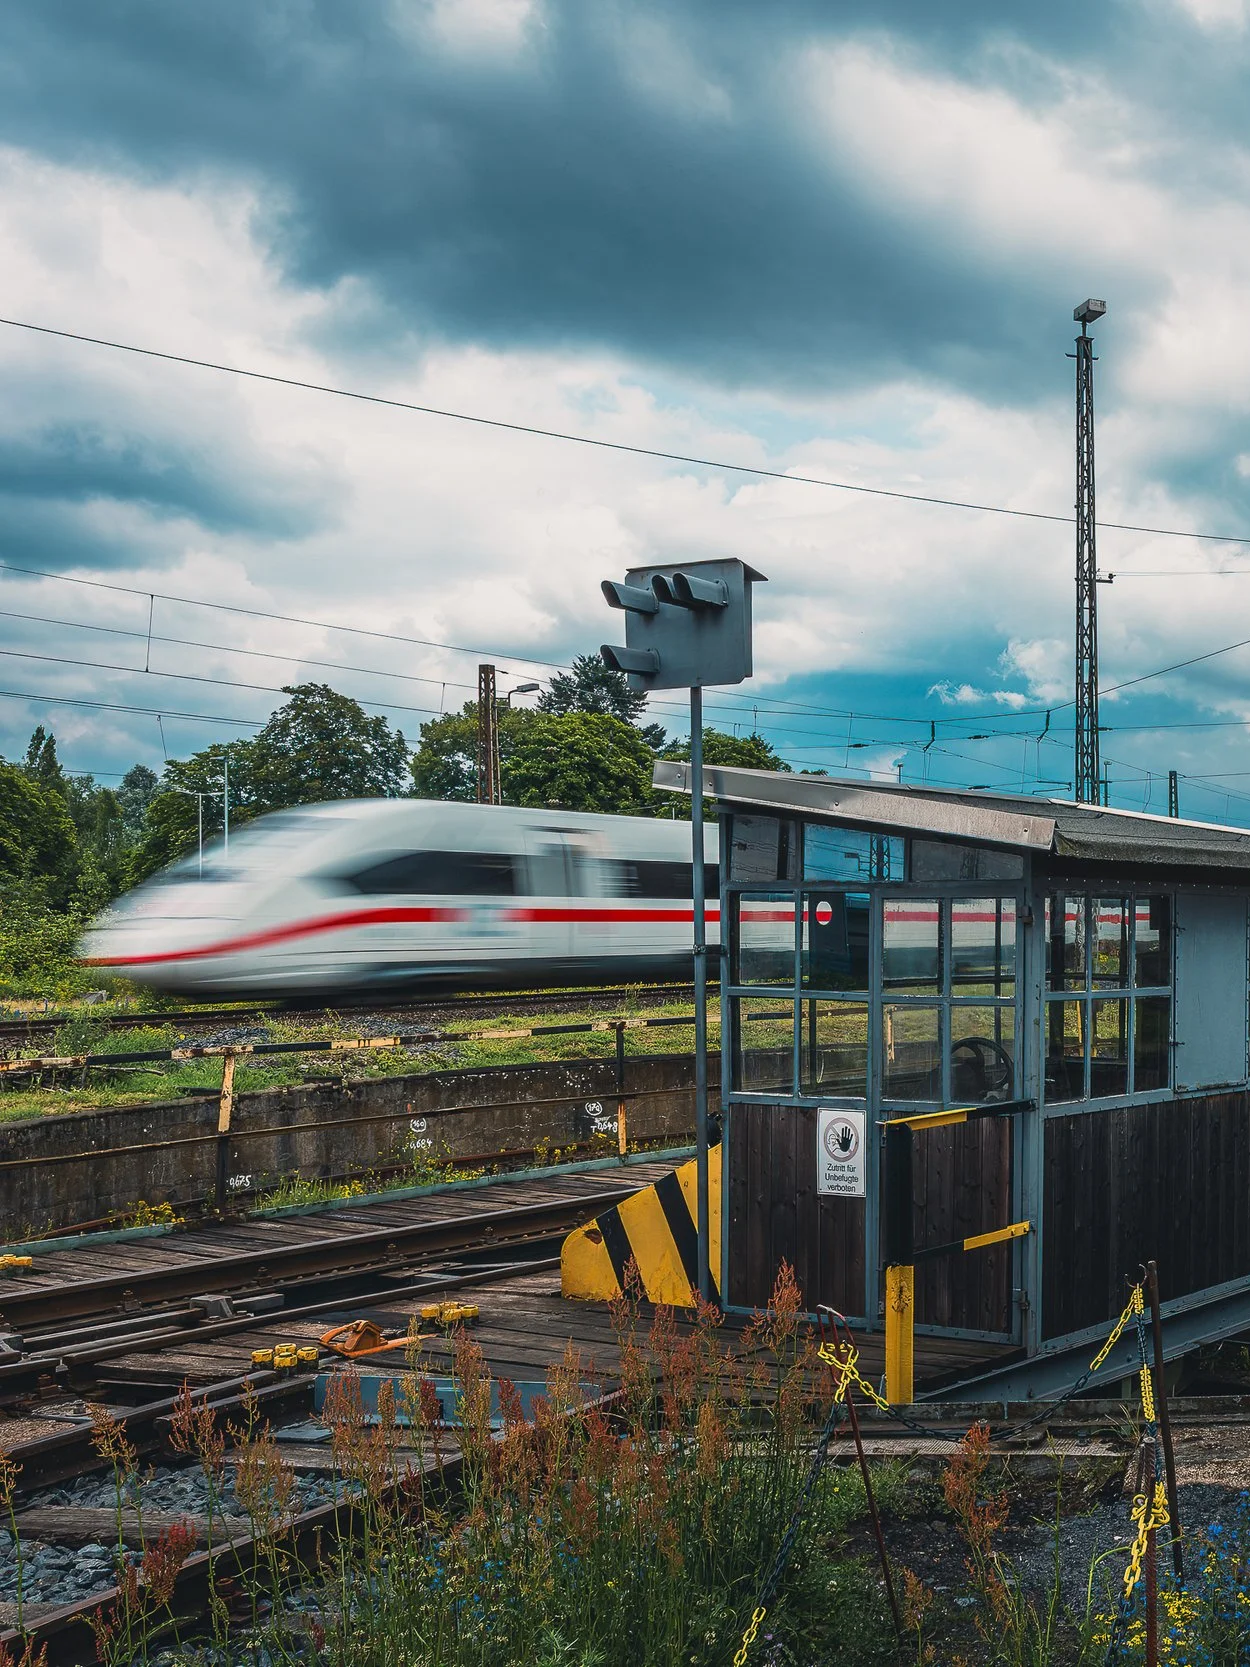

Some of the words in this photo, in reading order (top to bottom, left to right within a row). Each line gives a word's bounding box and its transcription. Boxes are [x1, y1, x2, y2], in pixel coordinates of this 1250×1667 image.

[827, 1163, 845, 1172] Zutritt
[825, 1173, 859, 1184] Unbefugte
[827, 1184, 856, 1192] verboten
